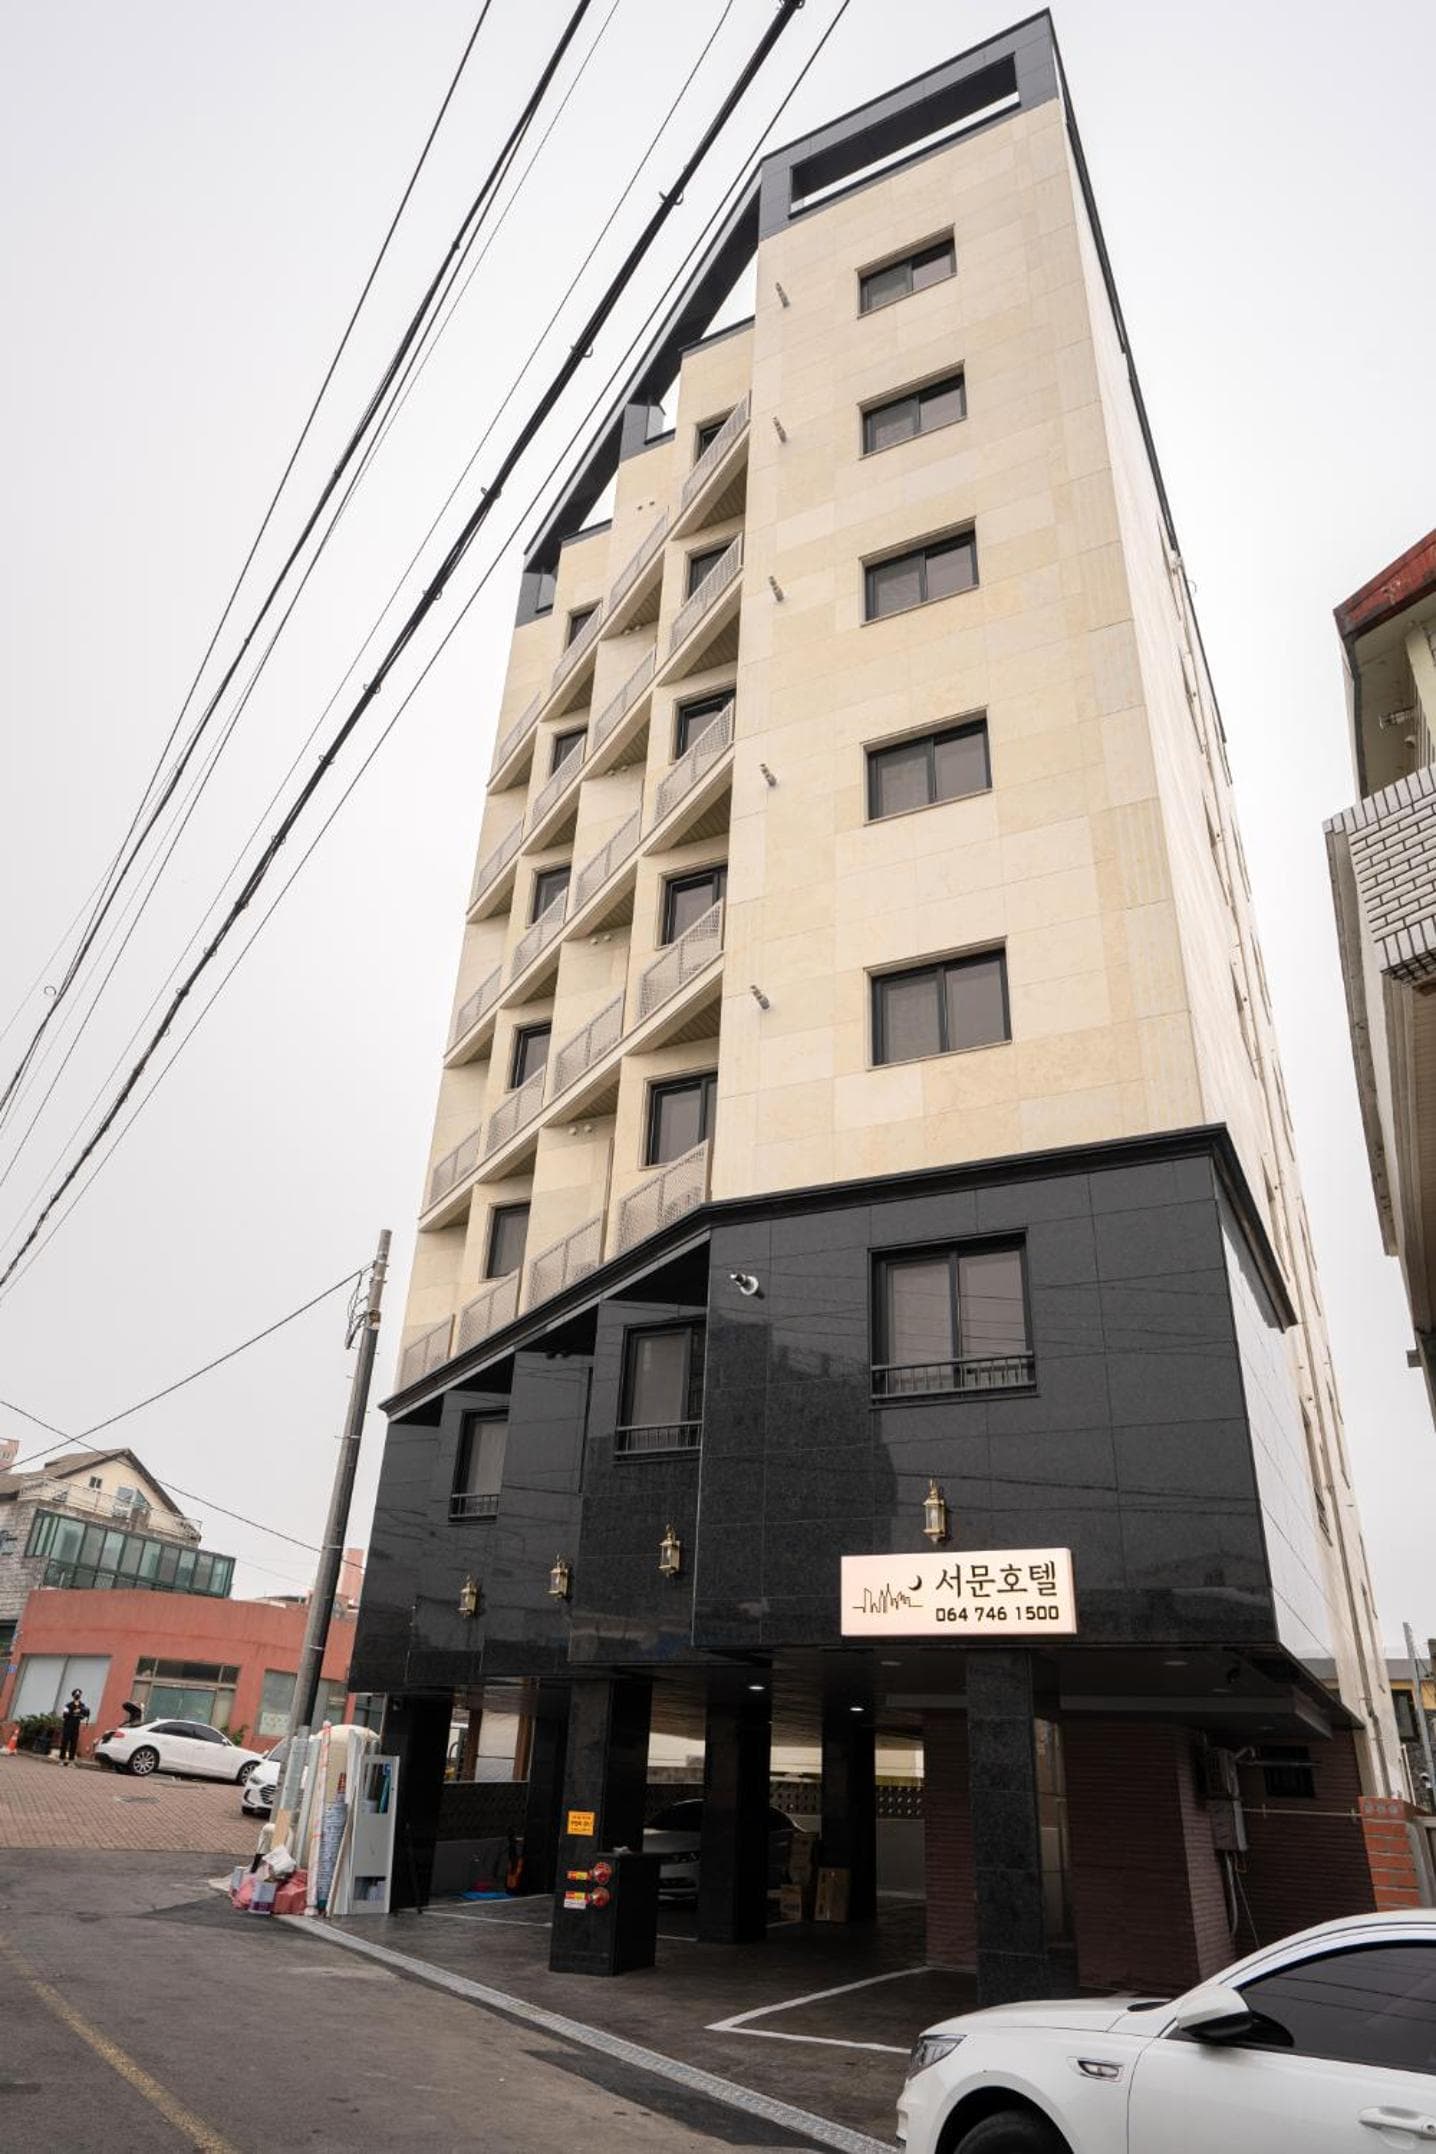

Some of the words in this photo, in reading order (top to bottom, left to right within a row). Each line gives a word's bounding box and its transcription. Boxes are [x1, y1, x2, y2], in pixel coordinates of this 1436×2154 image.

[935, 1560, 1058, 1599] 서문호텔
[935, 1607, 969, 1622] 064
[974, 1606, 1008, 1622] 746
[1015, 1605, 1060, 1621] 1500
